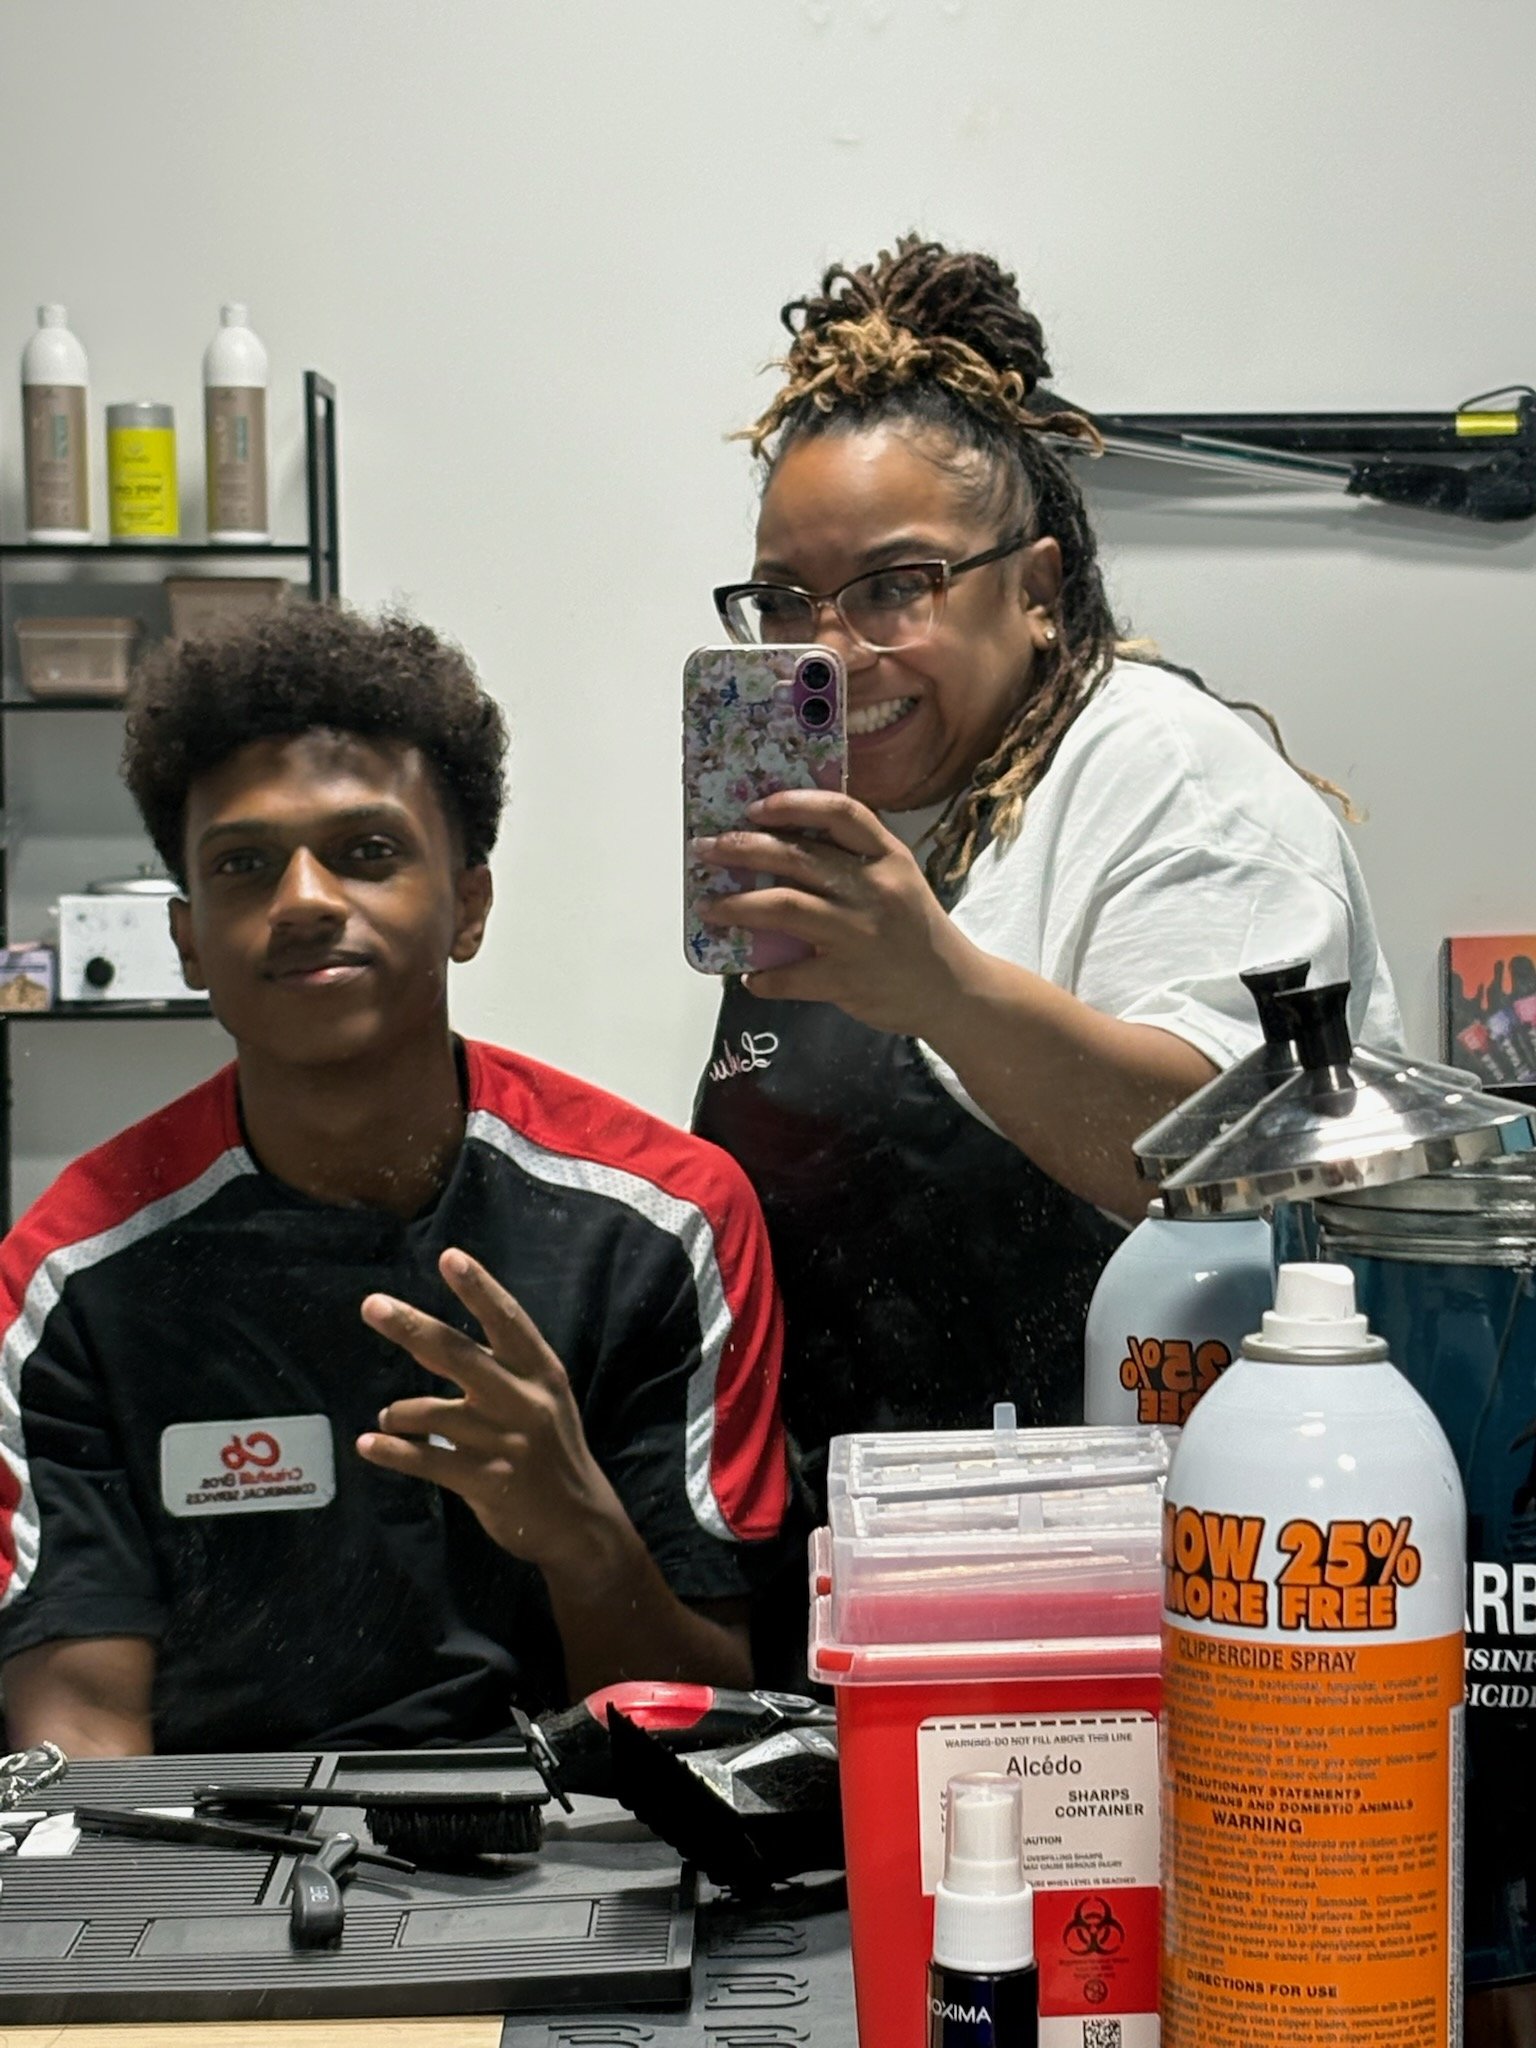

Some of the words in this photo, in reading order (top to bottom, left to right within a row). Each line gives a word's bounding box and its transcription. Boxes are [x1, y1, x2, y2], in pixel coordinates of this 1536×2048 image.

[1277, 1516, 1421, 1587] 25%
[1165, 1568, 1268, 1628] MORE
[1278, 1584, 1397, 1631] FREE
[1179, 1635, 1283, 1670] CLIPPERCIDE
[1291, 1649, 1356, 1672] SPRAY
[1011, 1737, 1029, 1746] NOT
[1032, 1735, 1051, 1745] FILL
[1054, 1734, 1086, 1744] ABOVE
[1088, 1733, 1109, 1743] THIS
[1112, 1732, 1133, 1742] LINE
[1006, 1755, 1082, 1776] Alcédo
[1068, 1789, 1130, 1802] SHARPS
[1175, 1769, 1264, 1796] PRECAUTIONARY
[1270, 1786, 1361, 1800] STATEMENTS
[1055, 1803, 1144, 1818] CONTAINER
[1195, 1790, 1243, 1808] HUMANS
[1248, 1799, 1275, 1812] AND
[1280, 1802, 1353, 1815] DOMESTIC
[1359, 1799, 1414, 1814] ANIMALS
[1212, 1810, 1302, 1834] WARNING
[1023, 1836, 1062, 1846] AUTION
[1047, 1879, 1069, 1888] WHEN
[1070, 1878, 1092, 1887] LEVEL
[1187, 1968, 1264, 1994] DIRECTIONS
[1270, 1983, 1301, 1997] FOR
[1307, 1985, 1338, 1998] USE
